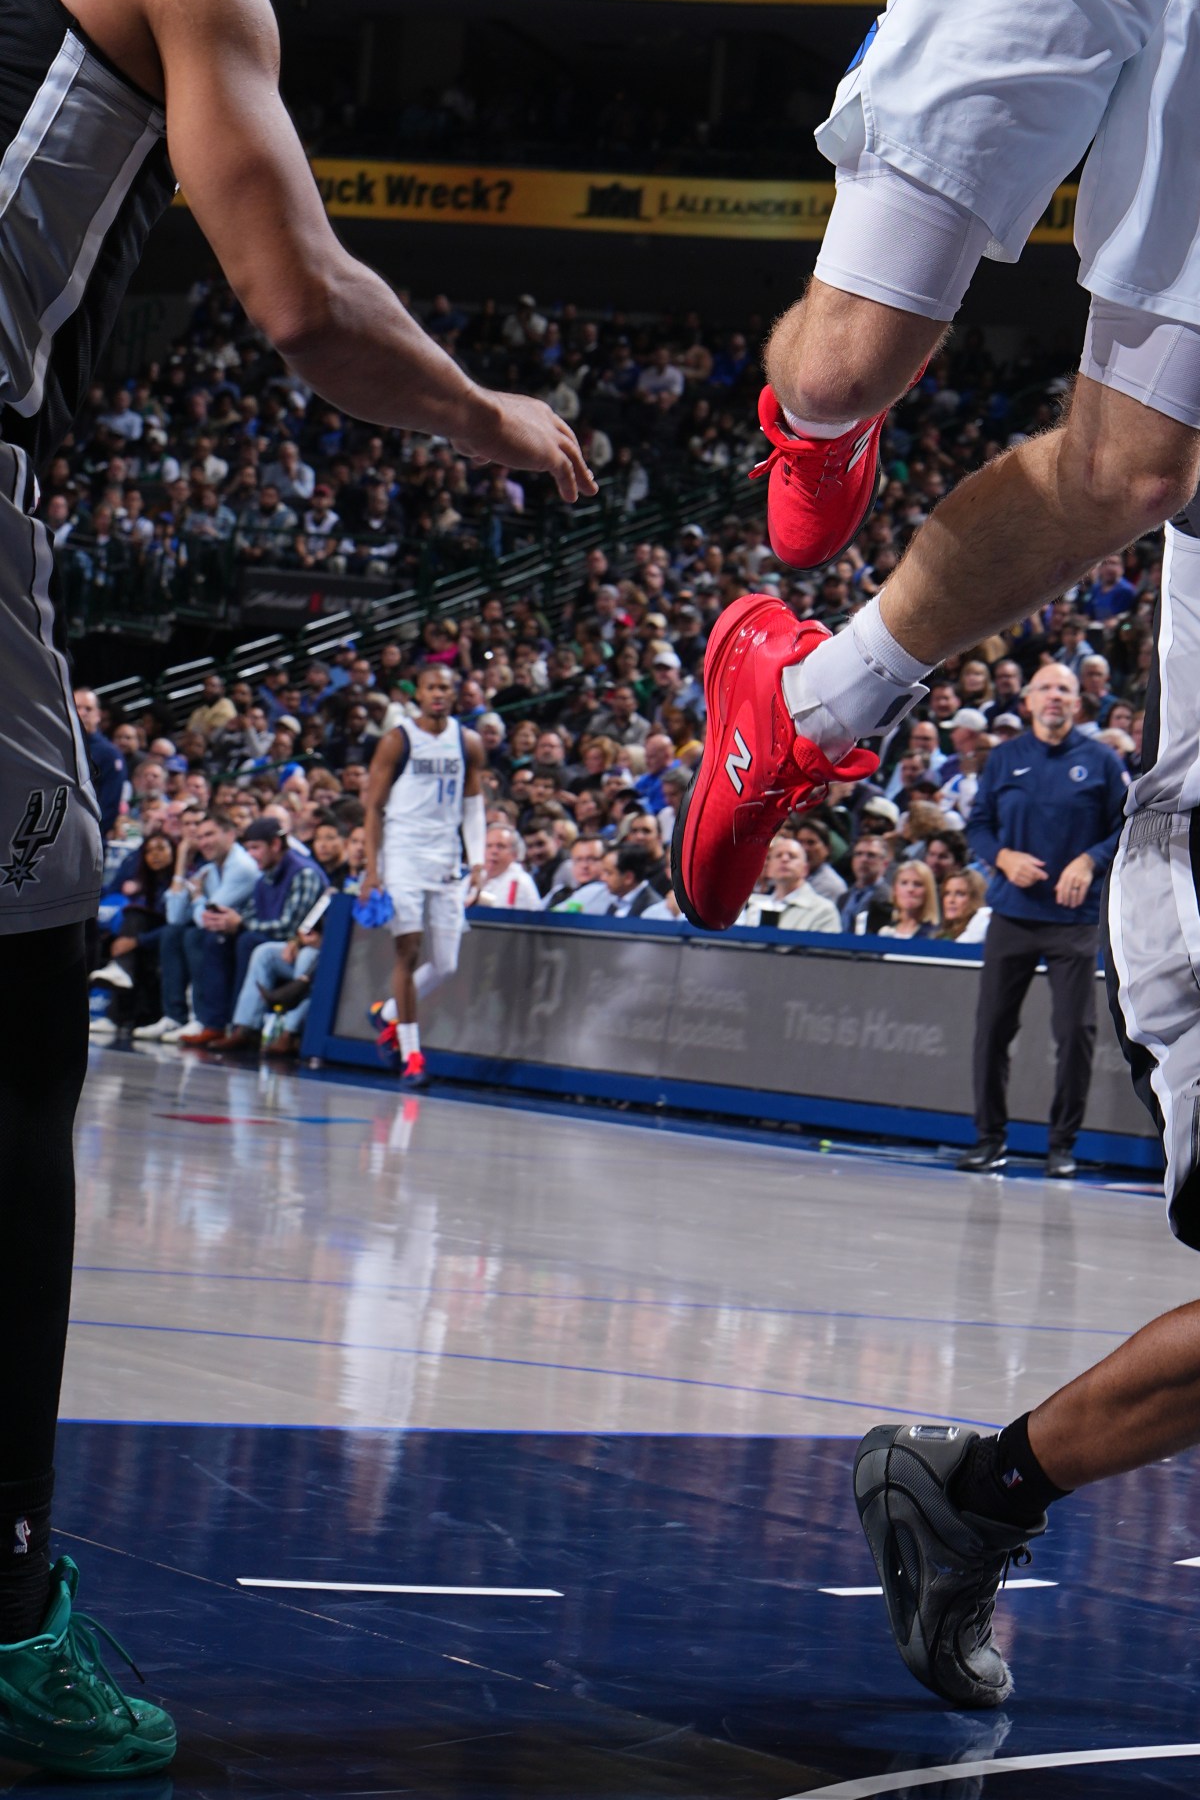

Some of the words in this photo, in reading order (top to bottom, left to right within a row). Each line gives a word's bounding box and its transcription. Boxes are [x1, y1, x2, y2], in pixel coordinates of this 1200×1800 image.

[384, 175, 513, 214] Wreck?
[412, 758, 460, 774] DALLAS
[438, 777, 457, 804] 14
[783, 1000, 834, 1045] This
[861, 1008, 947, 1057] Home.
